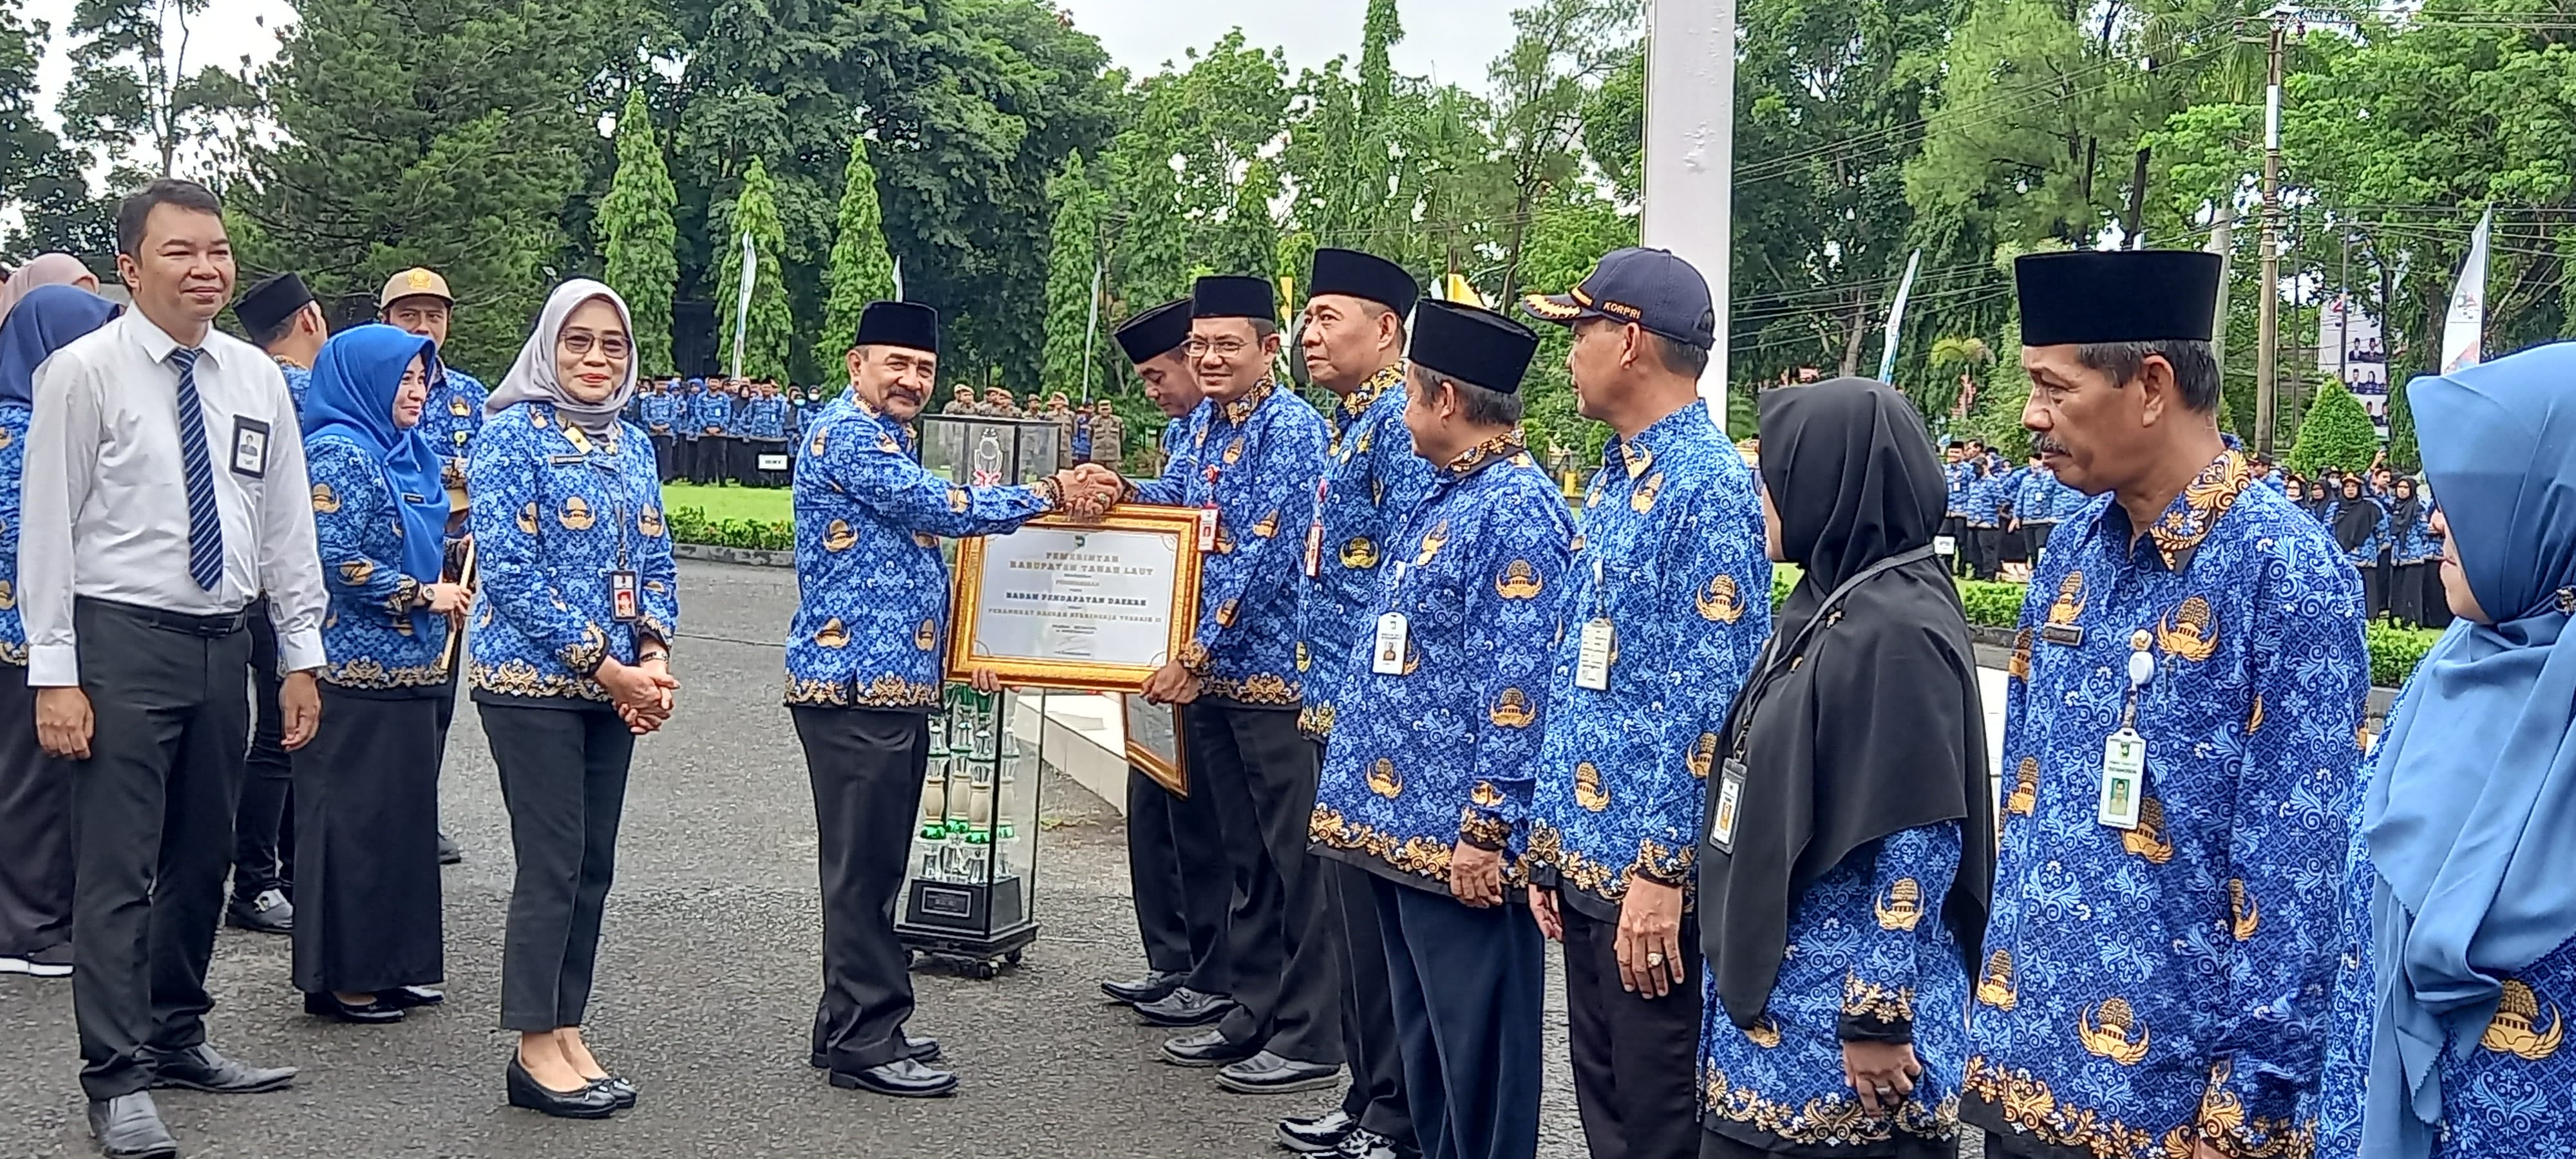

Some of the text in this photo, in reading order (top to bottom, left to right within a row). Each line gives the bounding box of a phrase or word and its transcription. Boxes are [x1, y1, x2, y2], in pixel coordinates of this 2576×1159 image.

[1603, 302, 1641, 319] KORPRI
[1046, 552, 1119, 562] PEMERINTAH
[1009, 561, 1077, 571] KABUPATEN
[1081, 565, 1120, 574] TANAH
[1006, 592, 1147, 607] BADAN PENDAPATAN DAERAH
